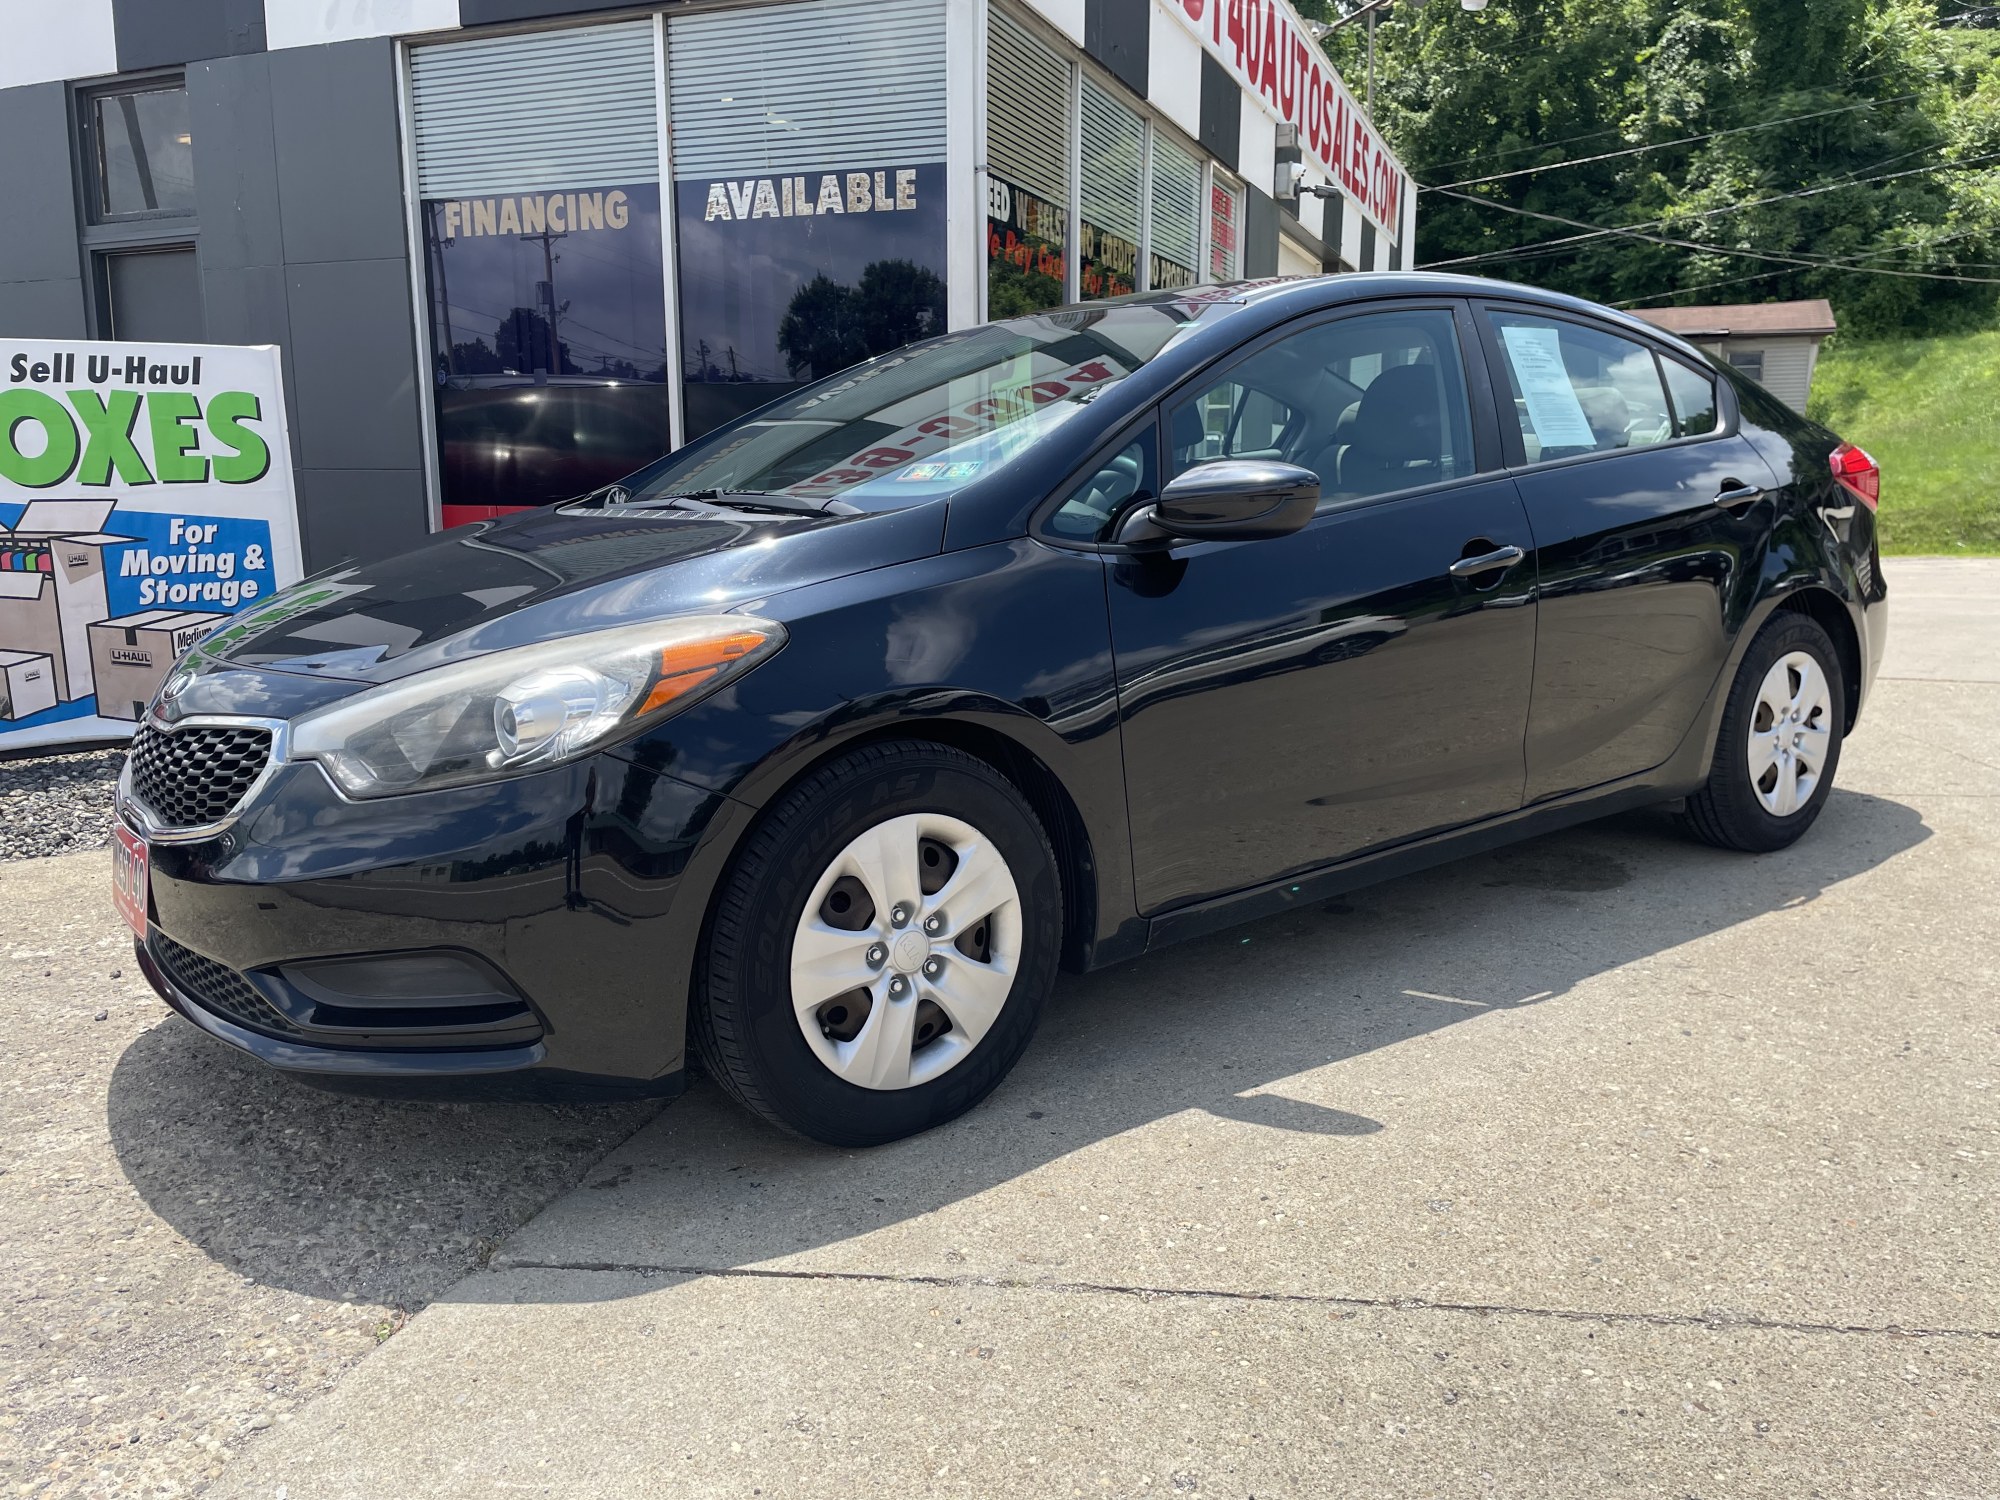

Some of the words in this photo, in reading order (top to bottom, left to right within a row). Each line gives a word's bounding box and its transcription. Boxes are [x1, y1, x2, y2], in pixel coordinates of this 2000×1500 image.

[445, 190, 629, 238] FINANCING
[705, 169, 917, 222] AVAILABLE
[987, 176, 1011, 222] EED
[1004, 230, 1033, 277] Pay
[10, 353, 75, 383] Sell
[88, 355, 203, 385] U-Haul
[0, 388, 271, 489] OXES
[169, 518, 218, 545] For
[120, 545, 236, 579] Moving
[243, 543, 266, 570] &
[139, 578, 259, 607] Storage
[177, 627, 212, 649] Medium
[112, 649, 152, 664] U-HAUL
[132, 853, 145, 913] 40
